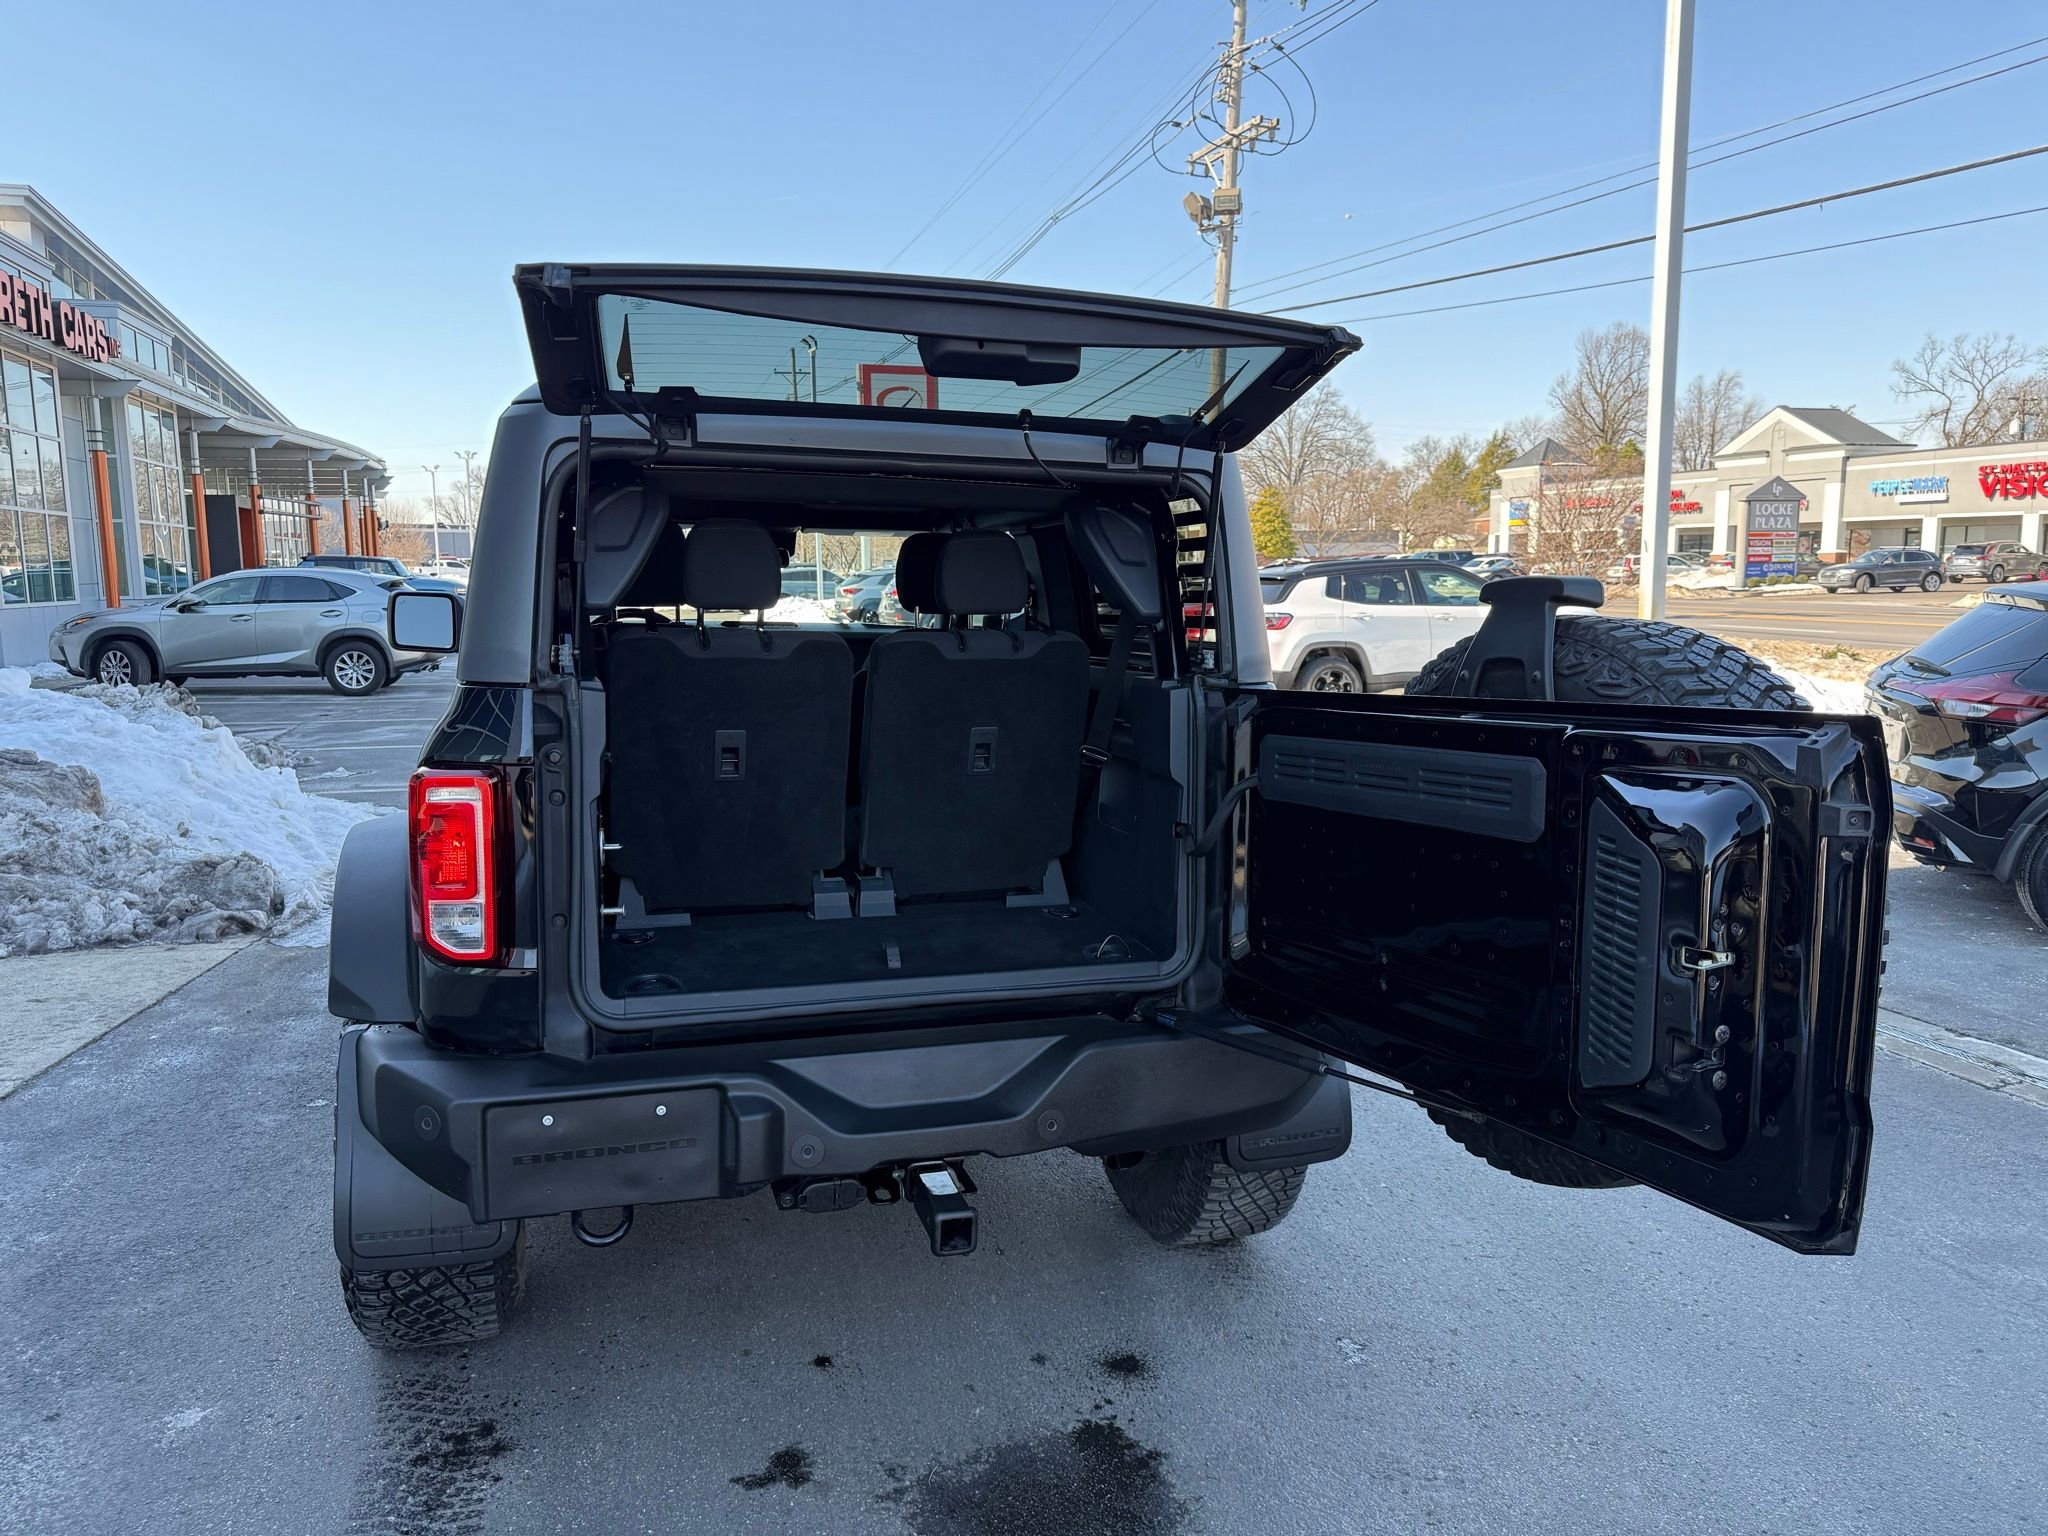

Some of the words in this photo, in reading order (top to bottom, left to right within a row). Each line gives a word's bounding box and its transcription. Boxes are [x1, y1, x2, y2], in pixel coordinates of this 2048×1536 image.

[0, 268, 55, 341] RETH
[60, 300, 109, 363] CARS
[1755, 503, 1793, 515] LOCKE
[1755, 517, 1792, 529] PLAZA
[1245, 1128, 1341, 1147] BRONCO
[512, 1137, 697, 1166] BRONCO
[354, 1223, 497, 1244] BRONCO
